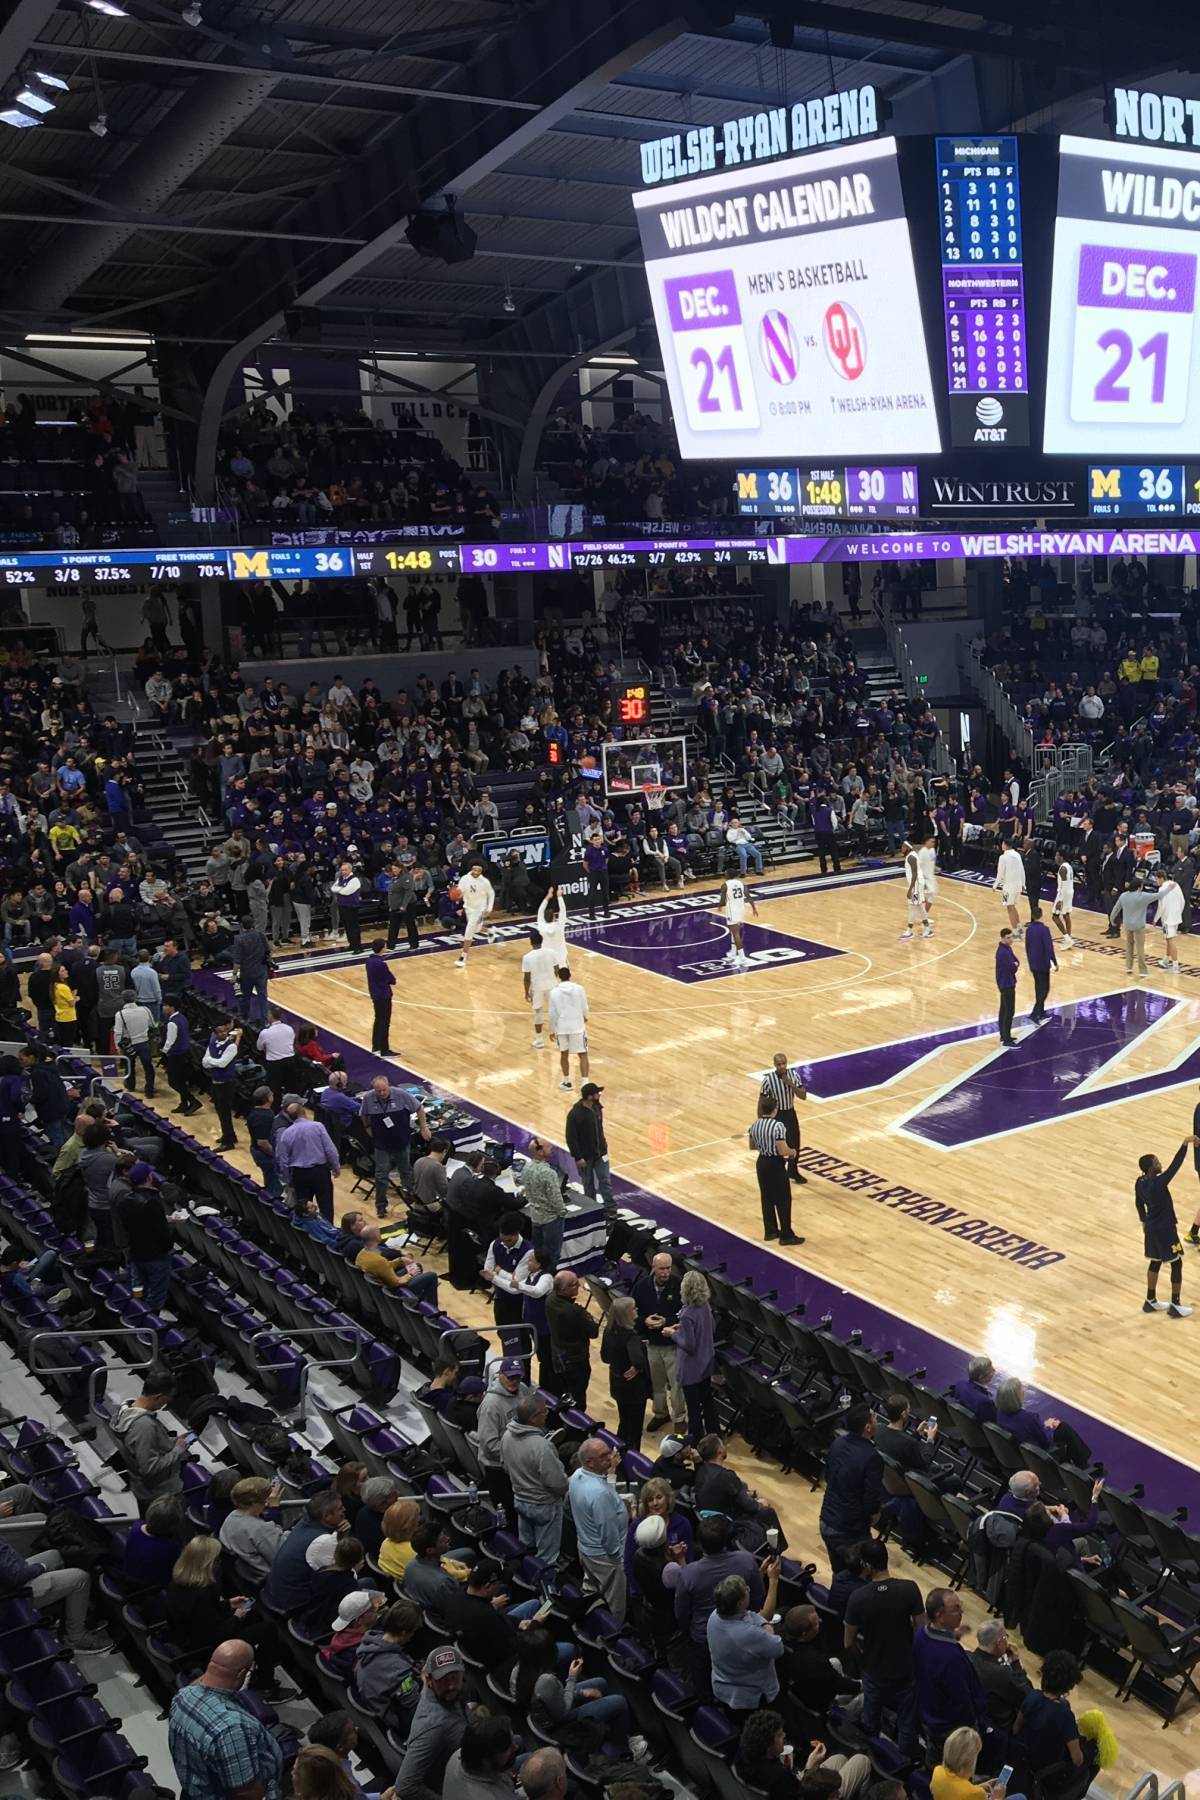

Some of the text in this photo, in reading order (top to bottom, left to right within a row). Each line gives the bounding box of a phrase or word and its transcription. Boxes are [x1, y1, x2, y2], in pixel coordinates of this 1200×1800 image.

[640, 85, 878, 184] WELSH-RYAN ARENA
[954, 147, 999, 156] MICHIGAN
[964, 167, 1013, 176] PTS RB F
[942, 182, 1014, 194] 1 3 1 1
[660, 172, 874, 249] WILDCAT CALENDAR
[944, 199, 952, 211] 2
[966, 199, 980, 211] 11
[990, 199, 997, 211] 1
[945, 215, 953, 227] 3
[990, 215, 998, 227] 3
[1008, 215, 1014, 227] 1
[946, 231, 954, 243] 4
[991, 231, 999, 243] 3
[946, 248, 960, 260] 13
[969, 248, 984, 260] 10
[992, 248, 999, 260] 1
[748, 260, 868, 296] MEN'S BASKETBALL
[948, 279, 1018, 288] NORTHWESTERN
[1102, 261, 1176, 300] DEC.
[678, 288, 728, 320] DEC.
[970, 299, 1018, 308] PTS RB F
[950, 314, 1020, 326] 4 2 3
[951, 330, 960, 342] 5
[973, 330, 987, 342] 16
[996, 330, 1004, 342] 4
[952, 346, 1020, 357] 11 3 1
[952, 362, 1022, 372] 14 4 2
[1094, 328, 1169, 404] 21
[690, 345, 743, 413] 21
[954, 378, 1006, 388] 21 2
[799, 402, 812, 414] PM
[839, 394, 927, 413] WELSH-RYAN ARENA
[974, 428, 1007, 442] AT&T
[810, 470, 834, 479] 1ST HALF
[768, 472, 792, 501] 36
[858, 470, 885, 501] 30
[902, 471, 915, 499] N
[932, 477, 1074, 502] WINTRUST
[1138, 468, 1173, 500] 36
[806, 480, 842, 504] 1:48
[846, 533, 1196, 556] WELCOME TO WELSH-RYAN ARENA
[69, 556, 112, 564] POINT FG
[156, 553, 215, 562] FREE THROWS
[357, 552, 374, 560] HALF
[385, 550, 432, 570] 1:48
[472, 549, 497, 567] 30
[548, 545, 564, 568] N
[574, 554, 603, 566] 12/26
[607, 554, 636, 565] 46.2%
[649, 553, 665, 564] 3/7
[675, 552, 701, 562] 42.9%
[714, 551, 730, 562] 3/4
[748, 550, 766, 561] 75%
[315, 552, 343, 572] 36
[360, 562, 371, 570] 1ST
[6, 570, 35, 583] 52%
[54, 568, 80, 582] 3/8
[94, 568, 130, 580] 37.5%
[150, 566, 180, 579] 7/10
[198, 566, 224, 577] 70%
[622, 699, 644, 720] 30
[732, 888, 742, 899] 23
[103, 974, 120, 989] 32
[795, 1146, 1067, 1271] WELSH-RYAN ARENA
